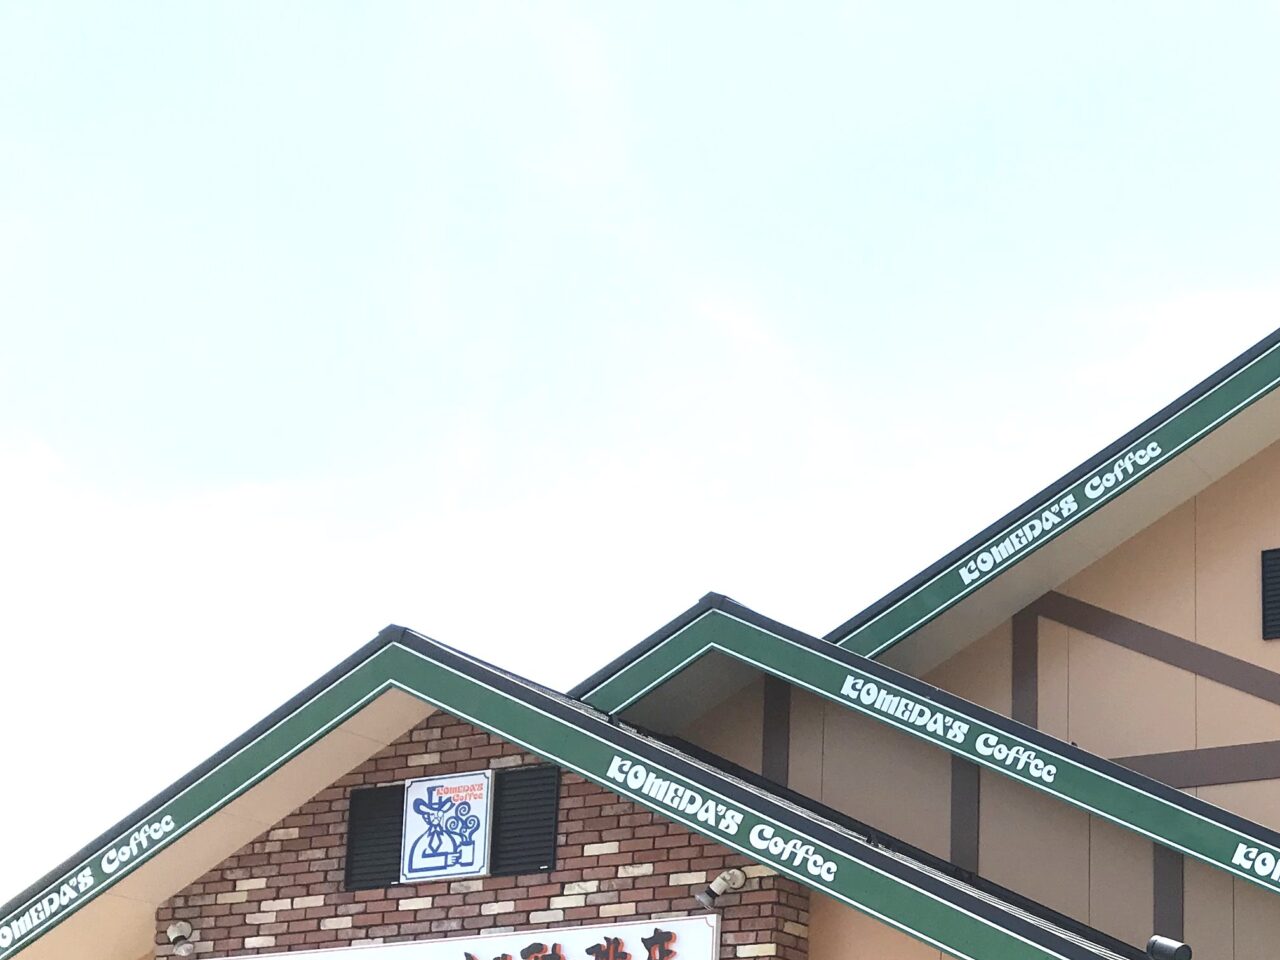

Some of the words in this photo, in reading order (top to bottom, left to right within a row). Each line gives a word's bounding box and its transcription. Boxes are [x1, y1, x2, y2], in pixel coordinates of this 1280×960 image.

[958, 493, 1078, 585] KOMEDA'S
[1084, 441, 1162, 499] Coffee
[841, 674, 969, 744] KOMEDA'S
[975, 733, 1056, 783] Coffee
[0, 866, 94, 948] OMEDA'S
[101, 815, 175, 874] Coffee
[606, 755, 744, 835] KOMEDA'S
[749, 824, 838, 882] Coffee
